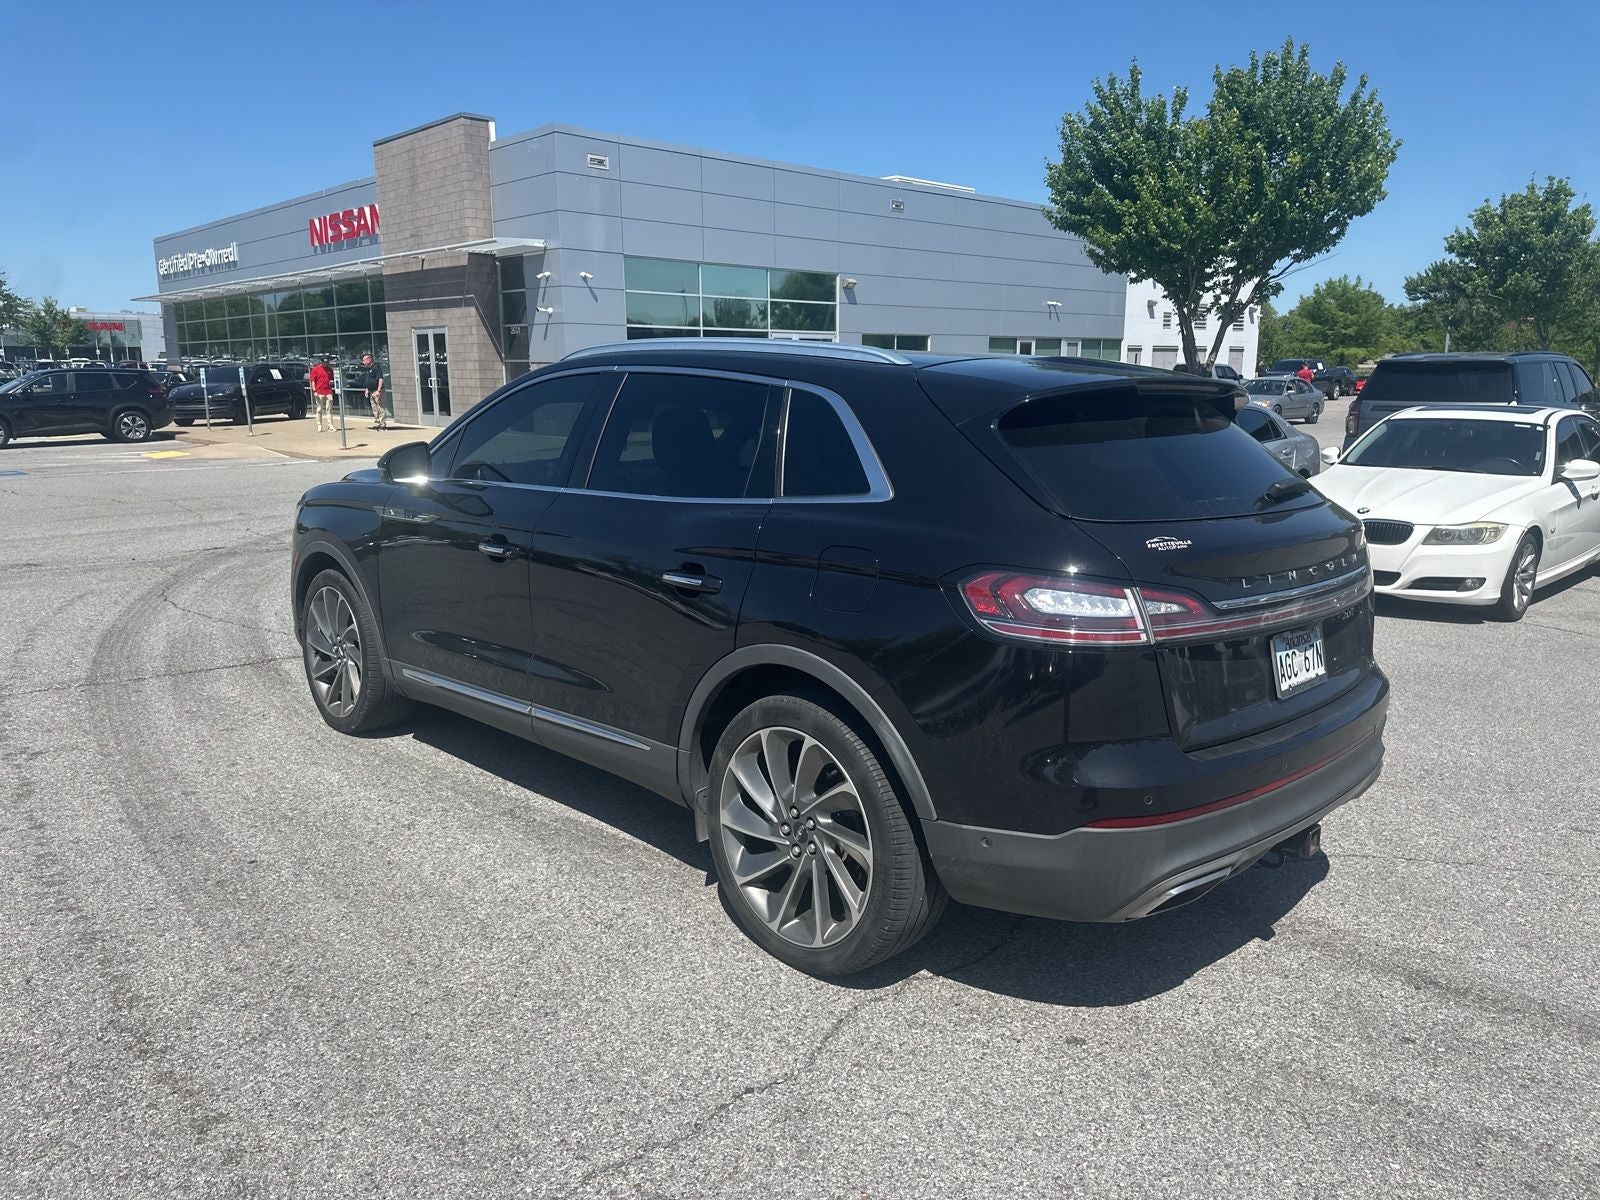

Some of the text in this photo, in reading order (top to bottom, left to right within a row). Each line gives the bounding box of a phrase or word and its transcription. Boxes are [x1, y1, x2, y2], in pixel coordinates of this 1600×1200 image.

[309, 204, 380, 247] NISSAN
[158, 241, 238, 276] Certified Pre-Owned
[1147, 540, 1192, 549] FAYETTEVILLE
[1241, 553, 1357, 589] LINCOLN
[1285, 632, 1312, 650] Arkansas
[1279, 641, 1324, 684] AGC 67N
